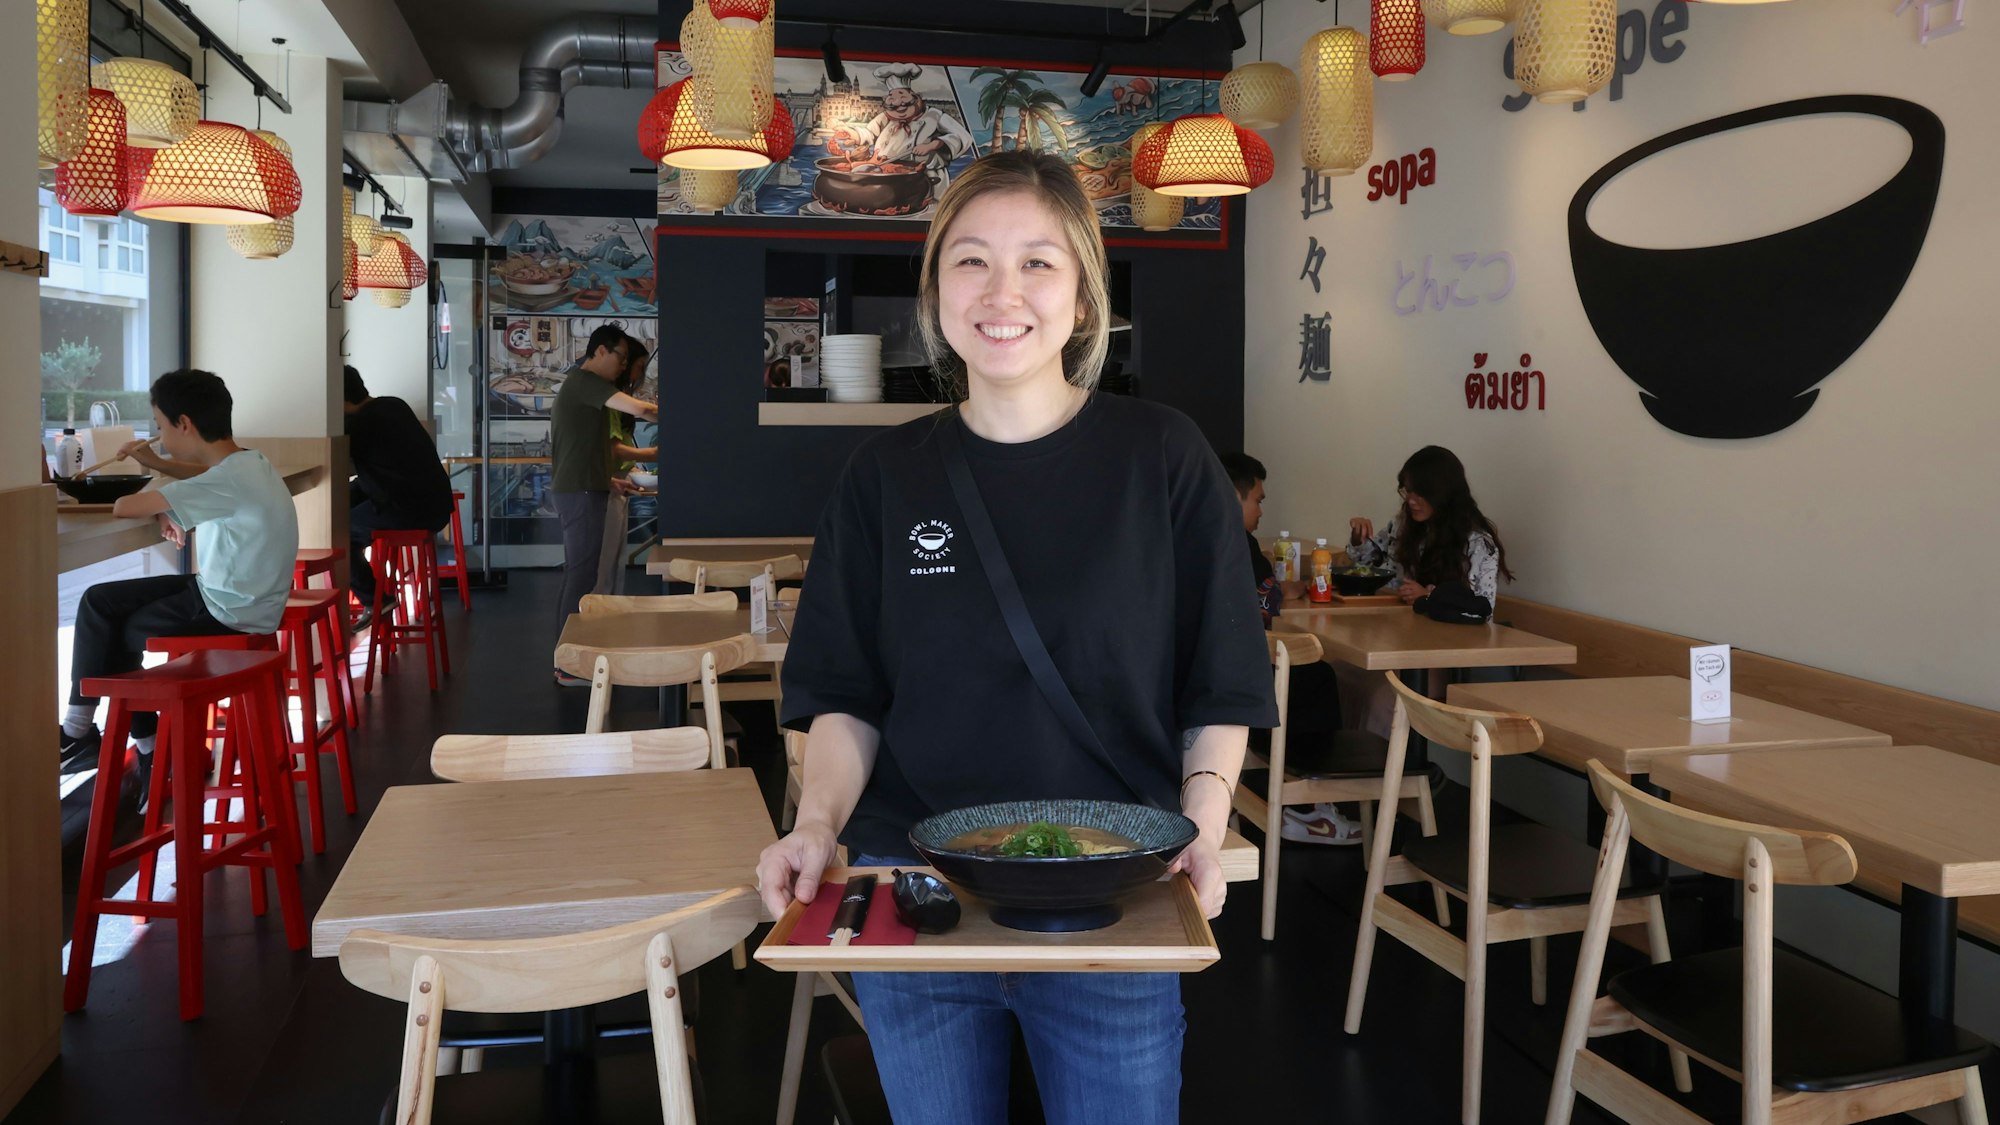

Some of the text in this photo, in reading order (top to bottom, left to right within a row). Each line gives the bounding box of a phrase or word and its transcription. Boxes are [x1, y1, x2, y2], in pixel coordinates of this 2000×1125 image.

[1367, 148, 1436, 205] sopa
[1392, 250, 1517, 317] とんこつ
[1465, 352, 1546, 411] ต้มยำ
[909, 519, 954, 541] BOWL MAKER
[910, 565, 956, 575] COLOGNE
[912, 546, 952, 561] SOCIETY
